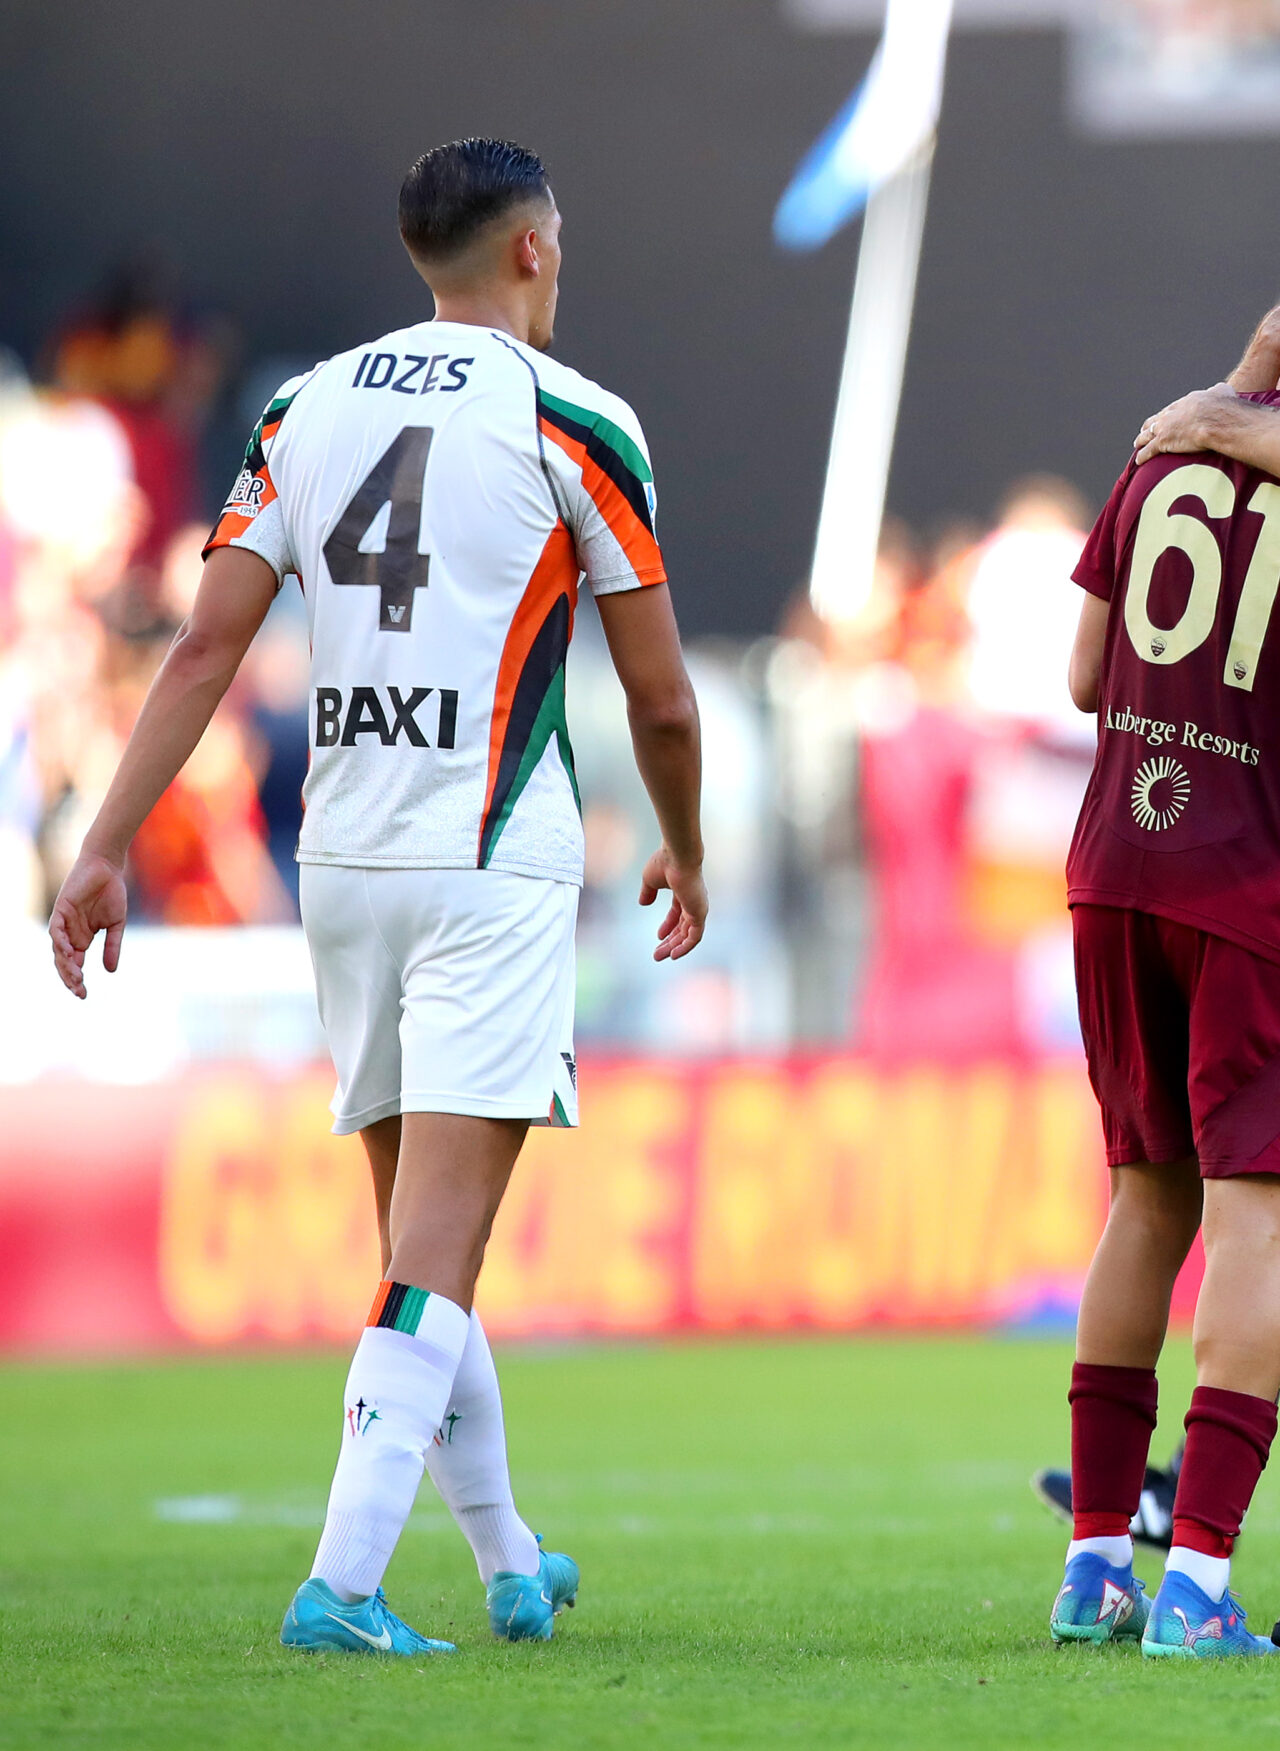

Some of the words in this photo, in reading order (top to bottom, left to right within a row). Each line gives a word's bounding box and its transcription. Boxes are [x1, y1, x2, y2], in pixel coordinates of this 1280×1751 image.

[351, 353, 475, 395] IDZES
[322, 426, 434, 632] 4
[315, 686, 459, 750] BAXI
[1104, 704, 1177, 746] Auberge
[1180, 721, 1260, 767] Resorts
